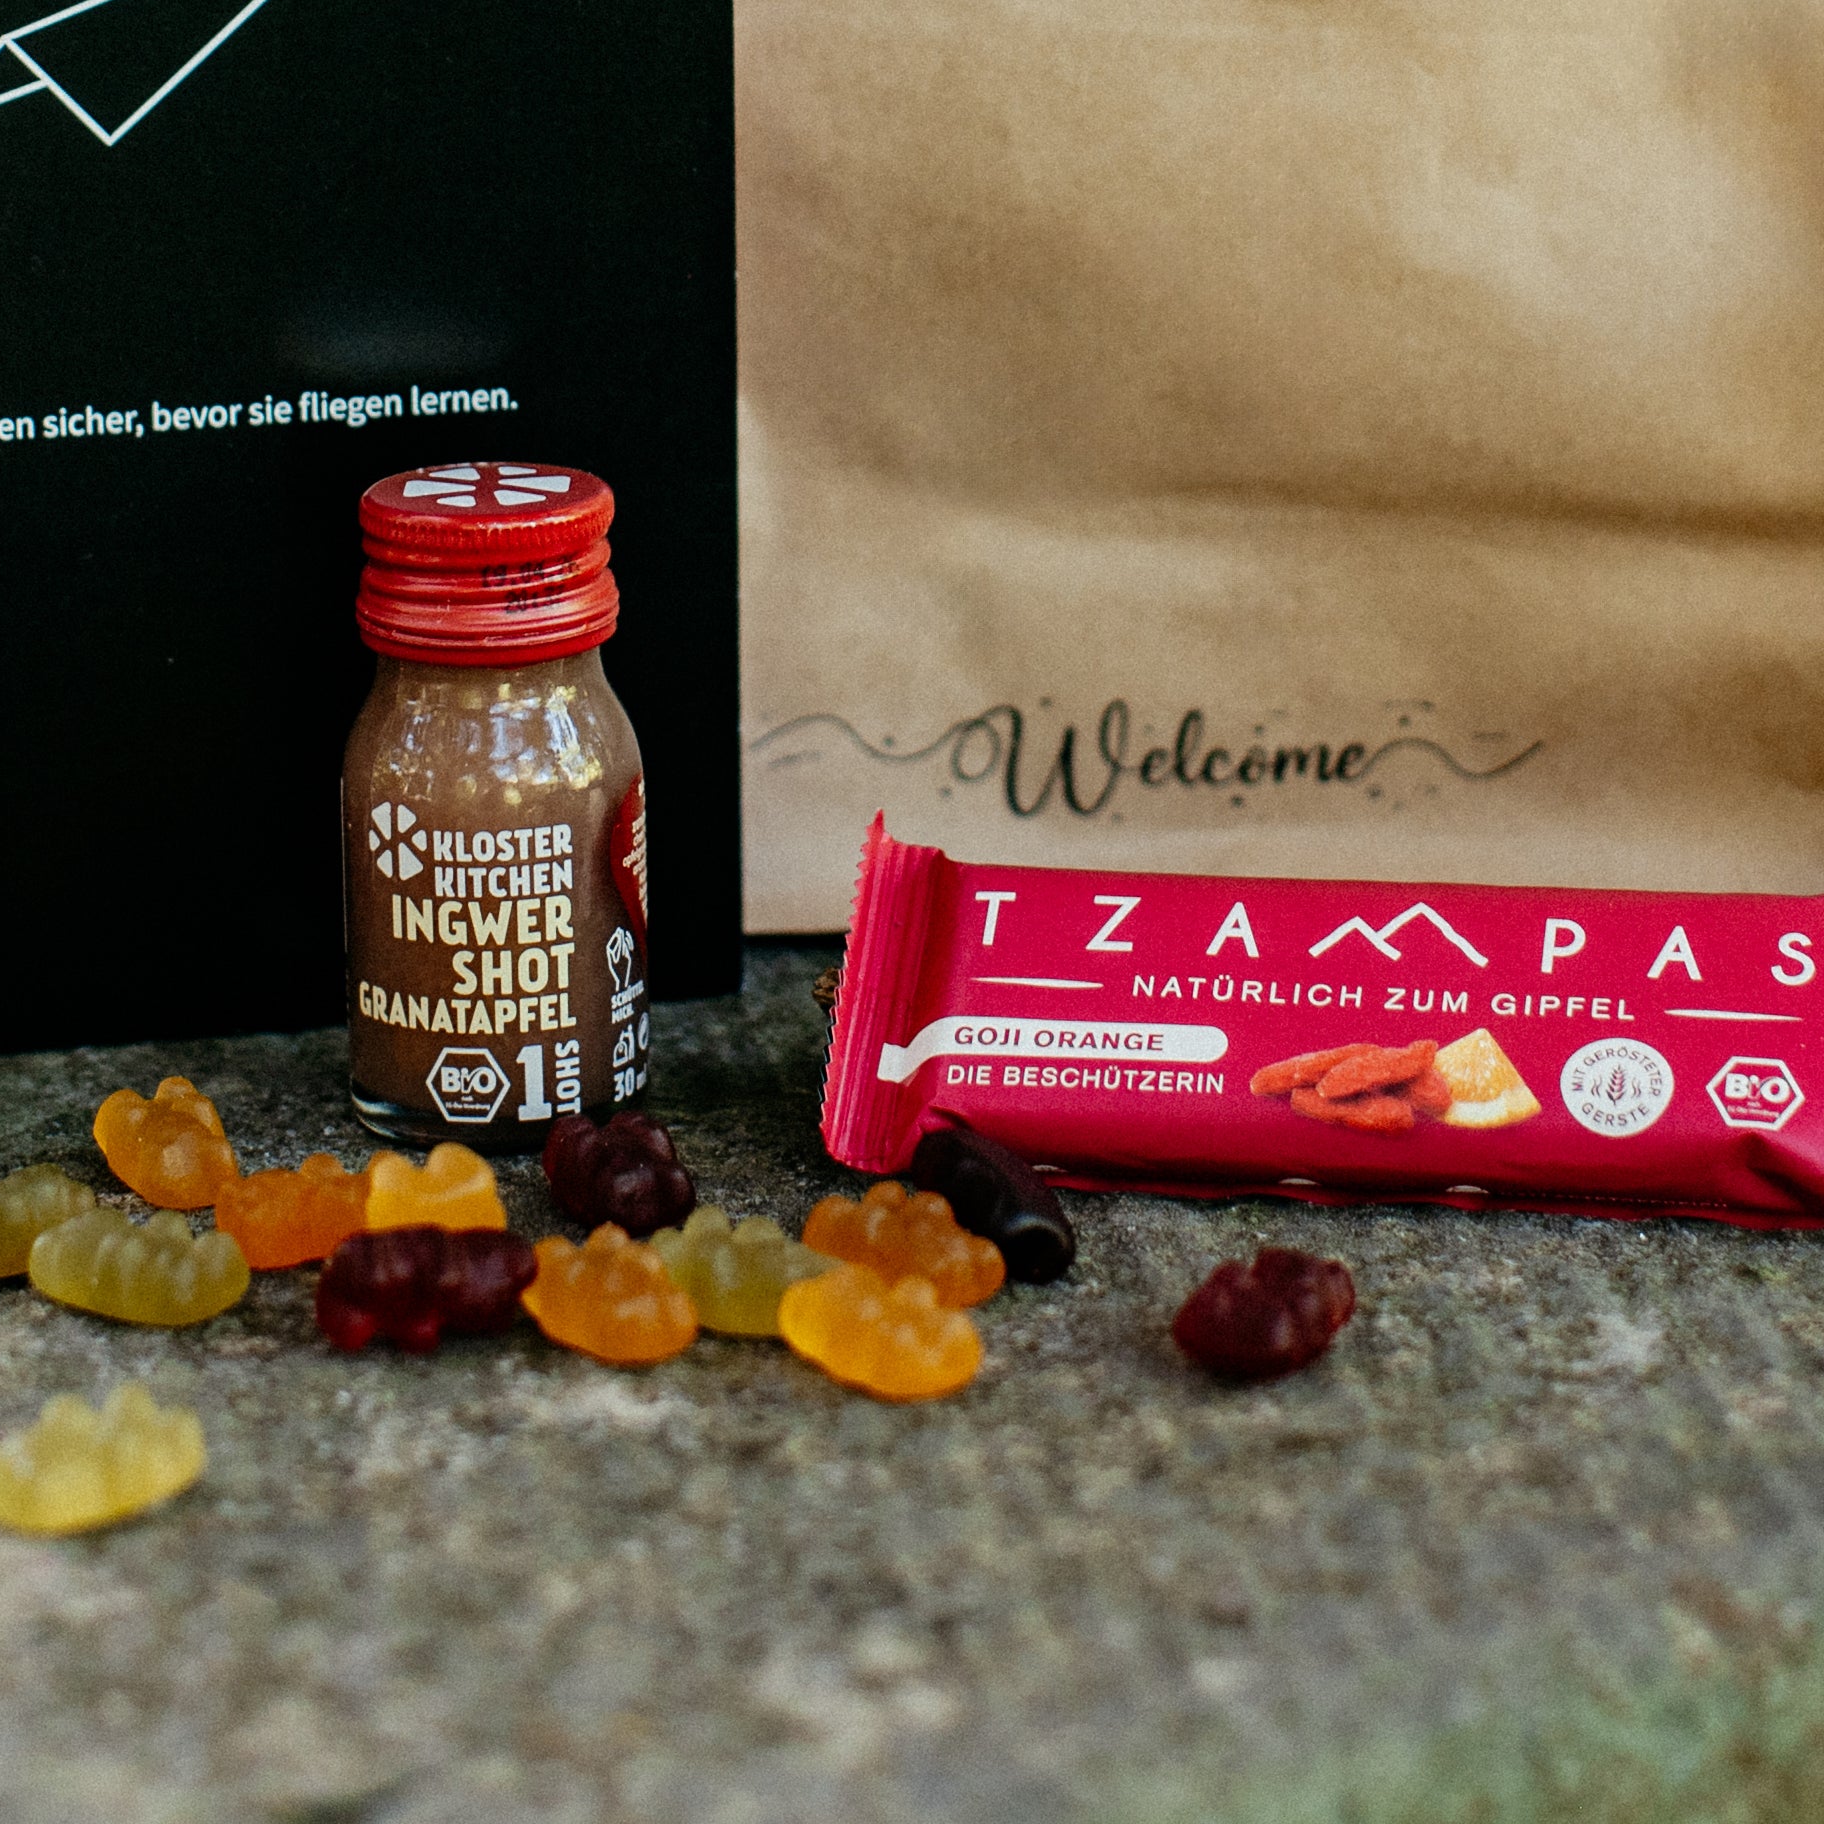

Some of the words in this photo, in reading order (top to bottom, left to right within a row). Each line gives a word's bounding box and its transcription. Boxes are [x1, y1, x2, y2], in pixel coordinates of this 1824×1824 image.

[42, 404, 145, 440] sicher,
[152, 400, 243, 433] bevor
[248, 394, 293, 427] sie
[298, 390, 403, 428] fliegen
[410, 384, 519, 417] lernen.
[950, 697, 1371, 818] Welcome
[433, 823, 574, 863] KLOSTER
[434, 858, 573, 899] KITCHEN
[392, 893, 575, 946] INGWER
[452, 942, 576, 996] SHOT
[358, 980, 578, 1036] GRANATAPFEL
[1130, 973, 1364, 1009] NATÜRLICH
[1383, 987, 1469, 1014] ZUM
[1490, 992, 1636, 1022] GIPFEL
[953, 1026, 1022, 1047] GOJI
[1033, 1030, 1165, 1052] ORANGE
[515, 1043, 553, 1122] 1
[554, 1038, 581, 1115] SHOT
[613, 1066, 636, 1103] 30
[946, 1064, 993, 1086] DIE
[1002, 1064, 1226, 1095] BESCHÜTZERIN
[1570, 1068, 1587, 1092] MIT
[1582, 1045, 1664, 1098] GERÖSTETER
[1581, 1101, 1651, 1127] GERSTE
